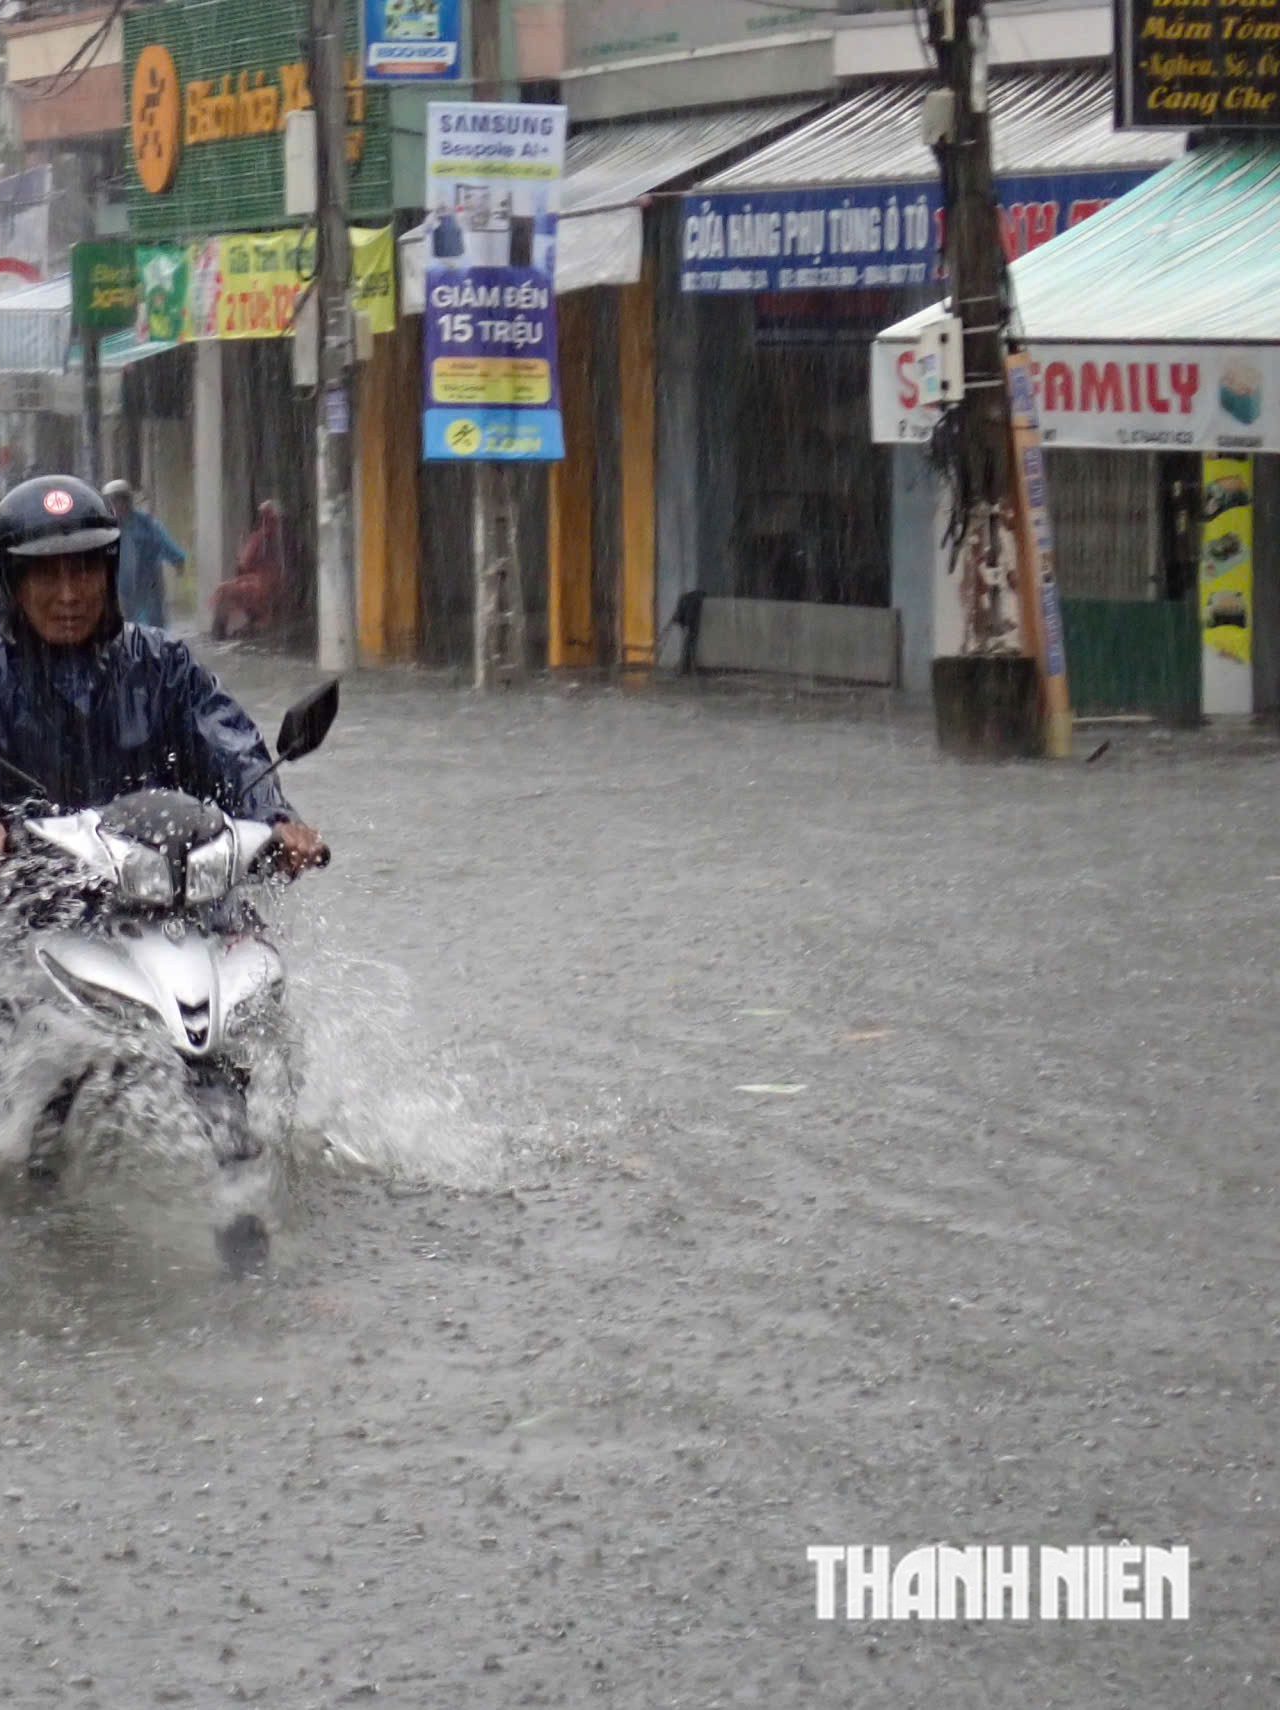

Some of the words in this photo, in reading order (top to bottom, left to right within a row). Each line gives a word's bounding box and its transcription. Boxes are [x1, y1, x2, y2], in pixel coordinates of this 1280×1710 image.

[439, 114, 554, 136] SAMSUNG
[431, 278, 500, 309] GIẢM
[437, 313, 474, 344] 15
